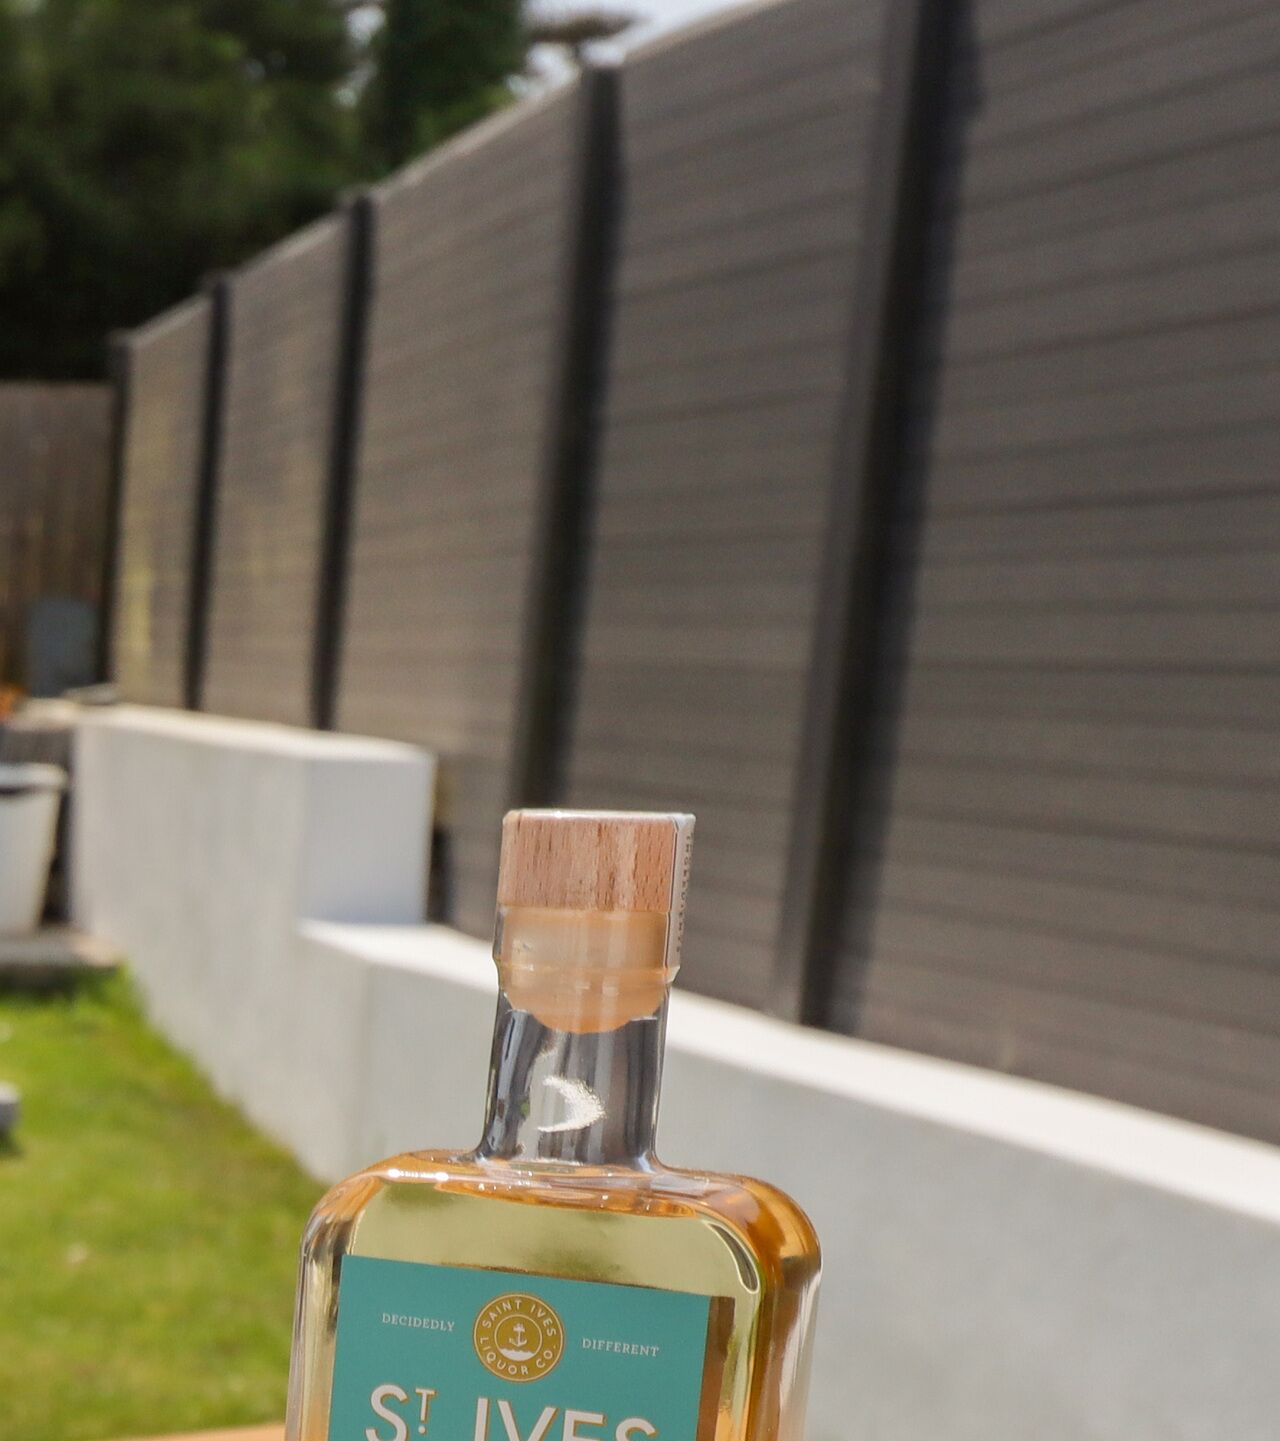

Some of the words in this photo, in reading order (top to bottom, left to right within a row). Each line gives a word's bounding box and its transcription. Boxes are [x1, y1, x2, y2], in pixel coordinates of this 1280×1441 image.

[382, 1312, 455, 1332] DECIDEDLY
[482, 1300, 522, 1328] SAINT
[530, 1304, 556, 1336] IVES
[480, 1336, 528, 1375] LIQUOR
[582, 1337, 659, 1357] DIFFERENT
